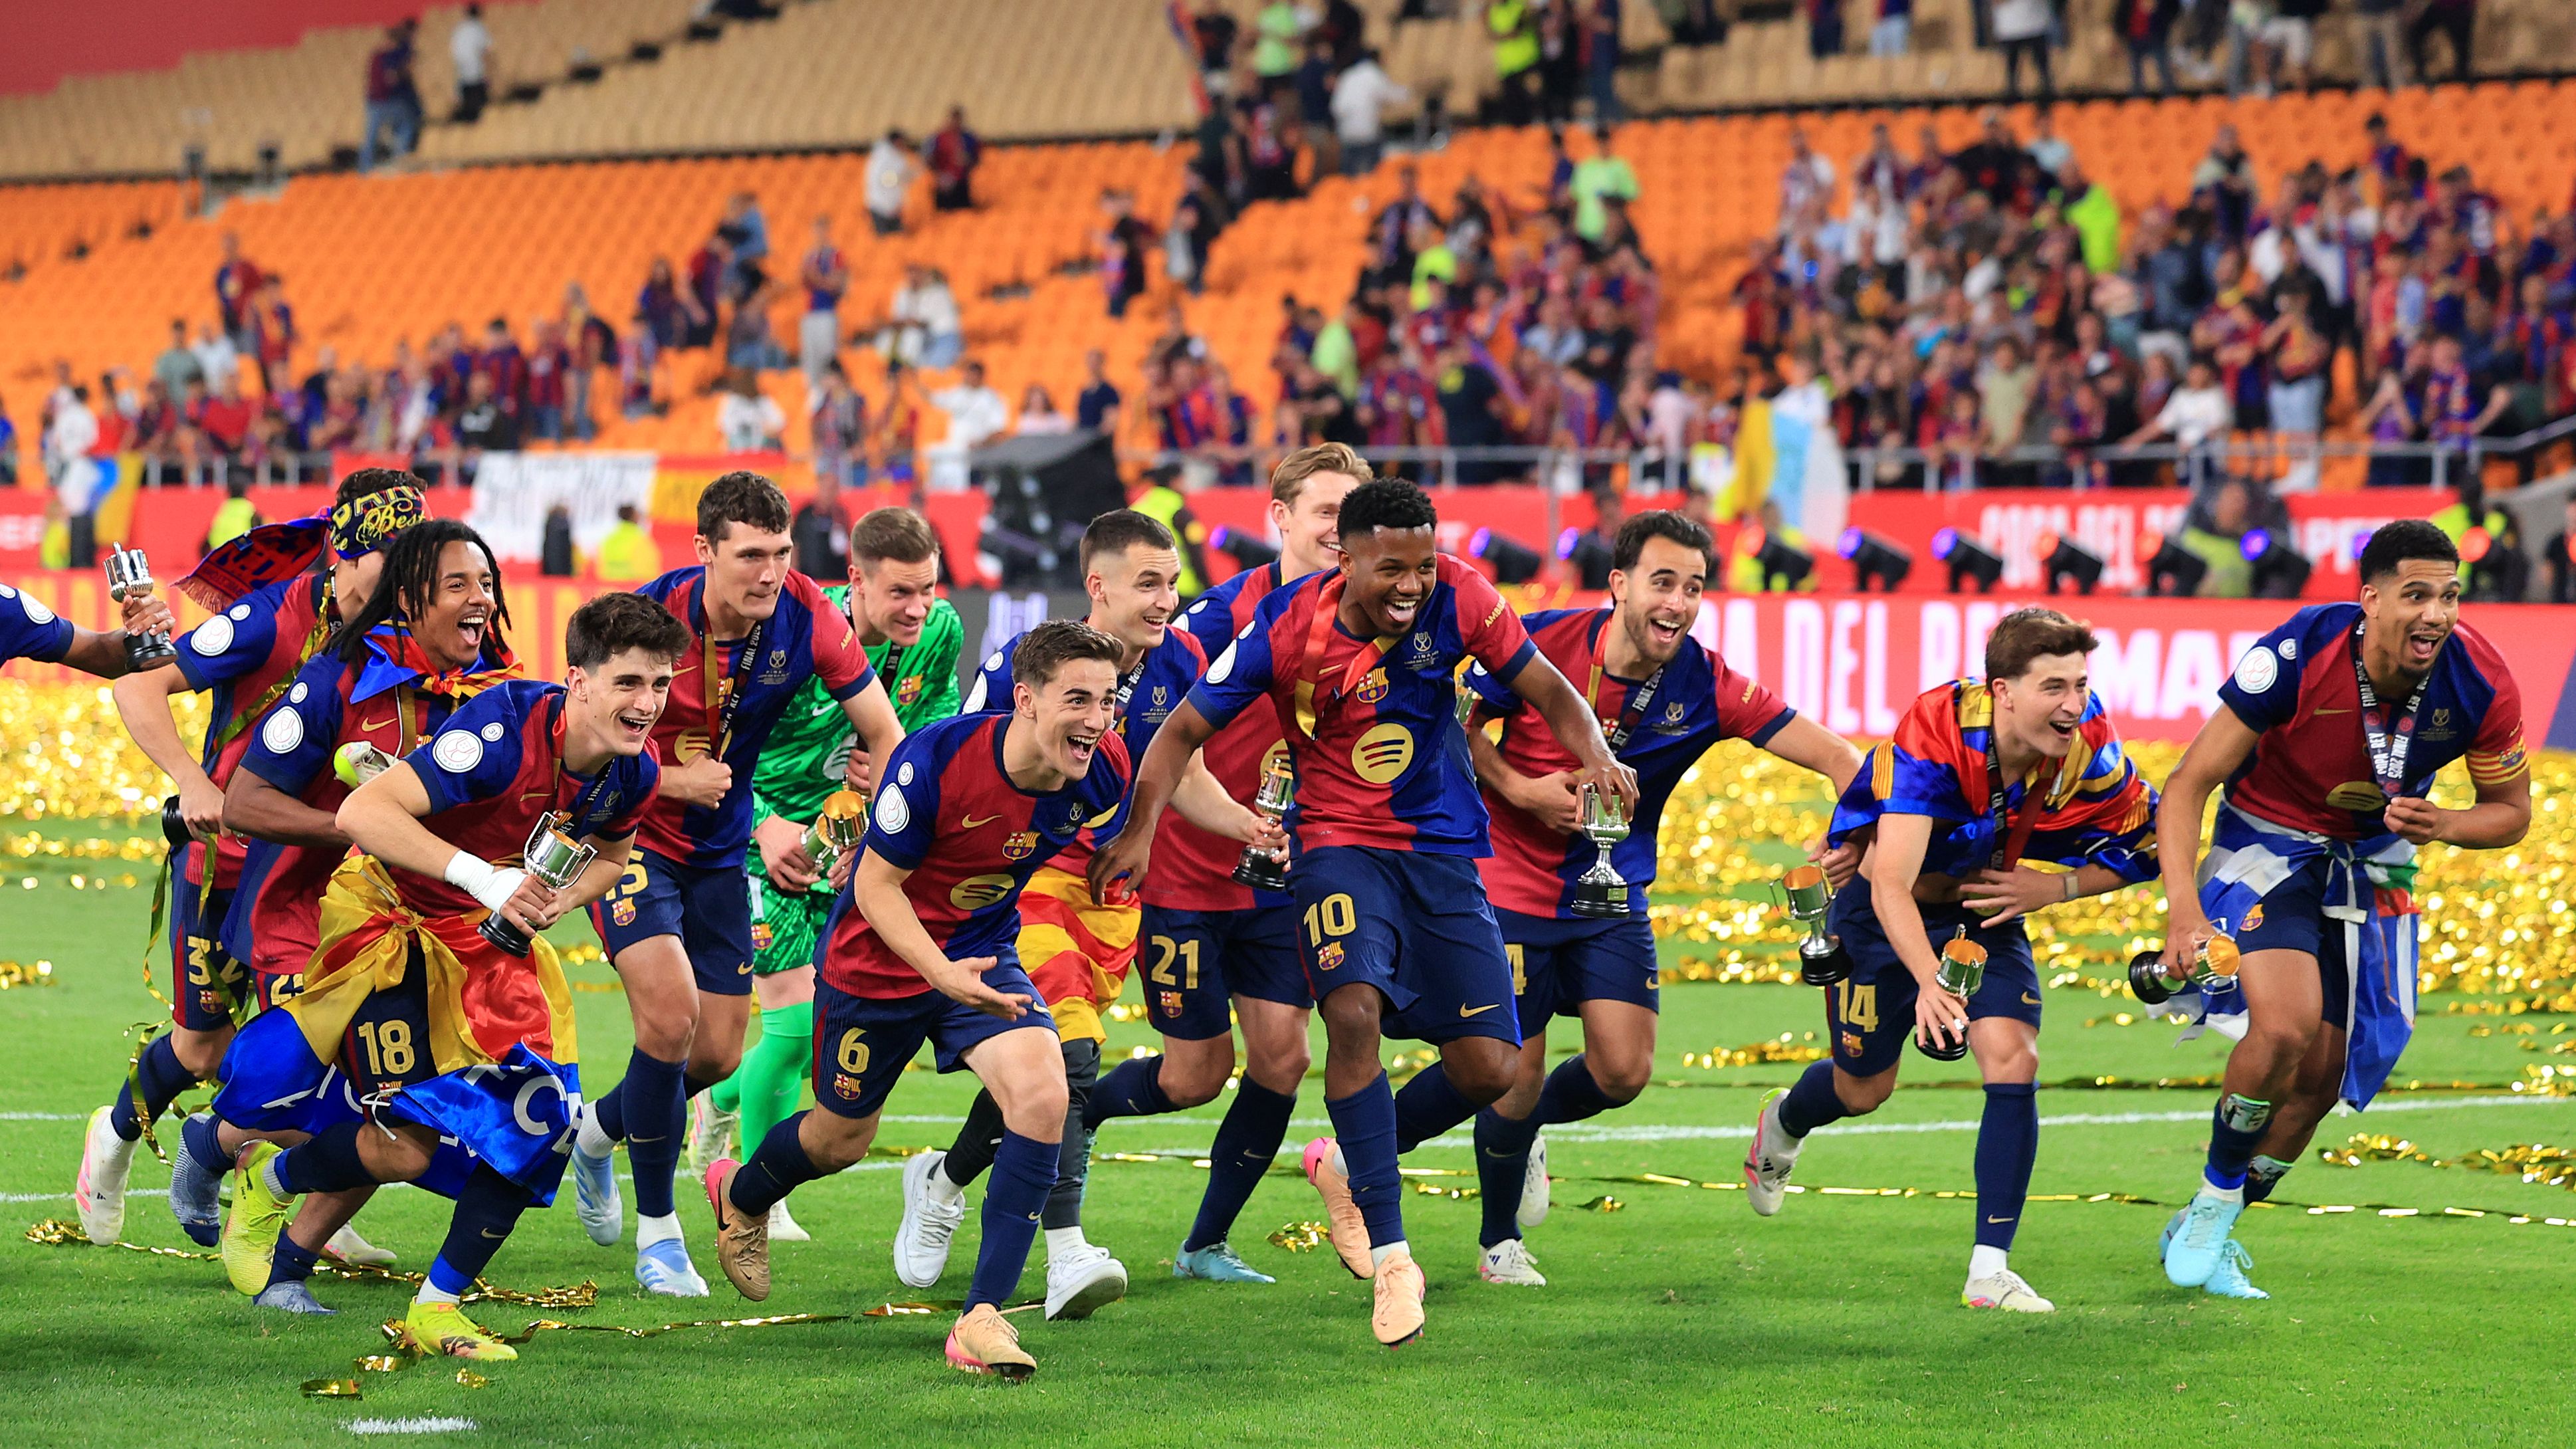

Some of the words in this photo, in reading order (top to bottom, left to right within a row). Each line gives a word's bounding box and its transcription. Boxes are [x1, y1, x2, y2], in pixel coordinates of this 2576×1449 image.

[1128, 662, 1144, 685] COPA
[1782, 599, 1897, 736] DEL
[1117, 685, 1132, 703] REY
[2368, 732, 2387, 749] REY
[2373, 752, 2389, 775] COPA
[2391, 734, 2409, 759] FINAL
[2387, 759, 2405, 780] 2025
[605, 849, 649, 901] 5
[1303, 893, 1356, 948] 10
[1151, 935, 1199, 989] 21
[1834, 977, 1878, 1032] 14
[358, 1020, 415, 1075] 18
[837, 1027, 870, 1073] 6
